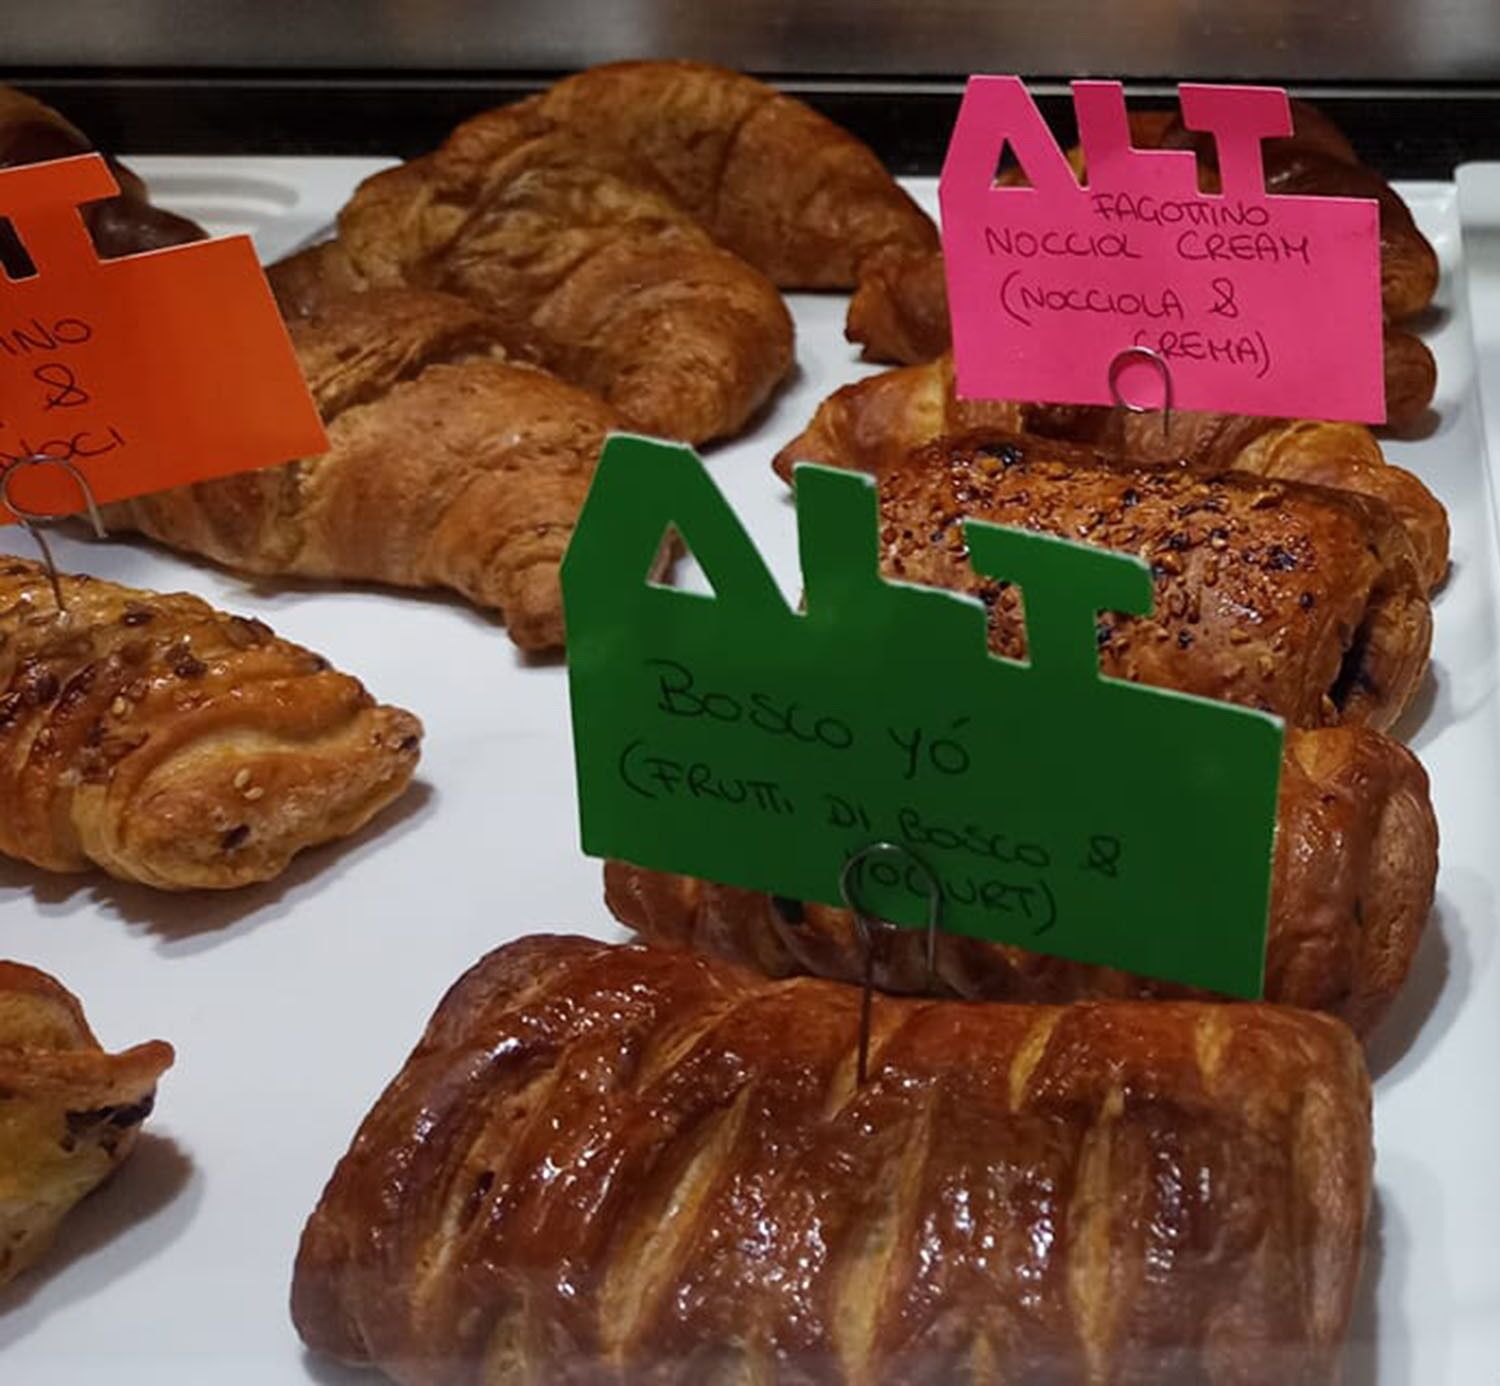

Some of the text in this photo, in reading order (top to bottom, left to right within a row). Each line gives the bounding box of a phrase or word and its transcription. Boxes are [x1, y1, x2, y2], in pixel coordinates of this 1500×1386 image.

[938, 75, 1294, 198] ALT
[1093, 193, 1270, 227] FAGOTTINO
[984, 227, 1310, 265] NOCCIOL CREAM
[1000, 270, 1185, 327] (NOCCIOLA
[560, 433, 1155, 682] ALT
